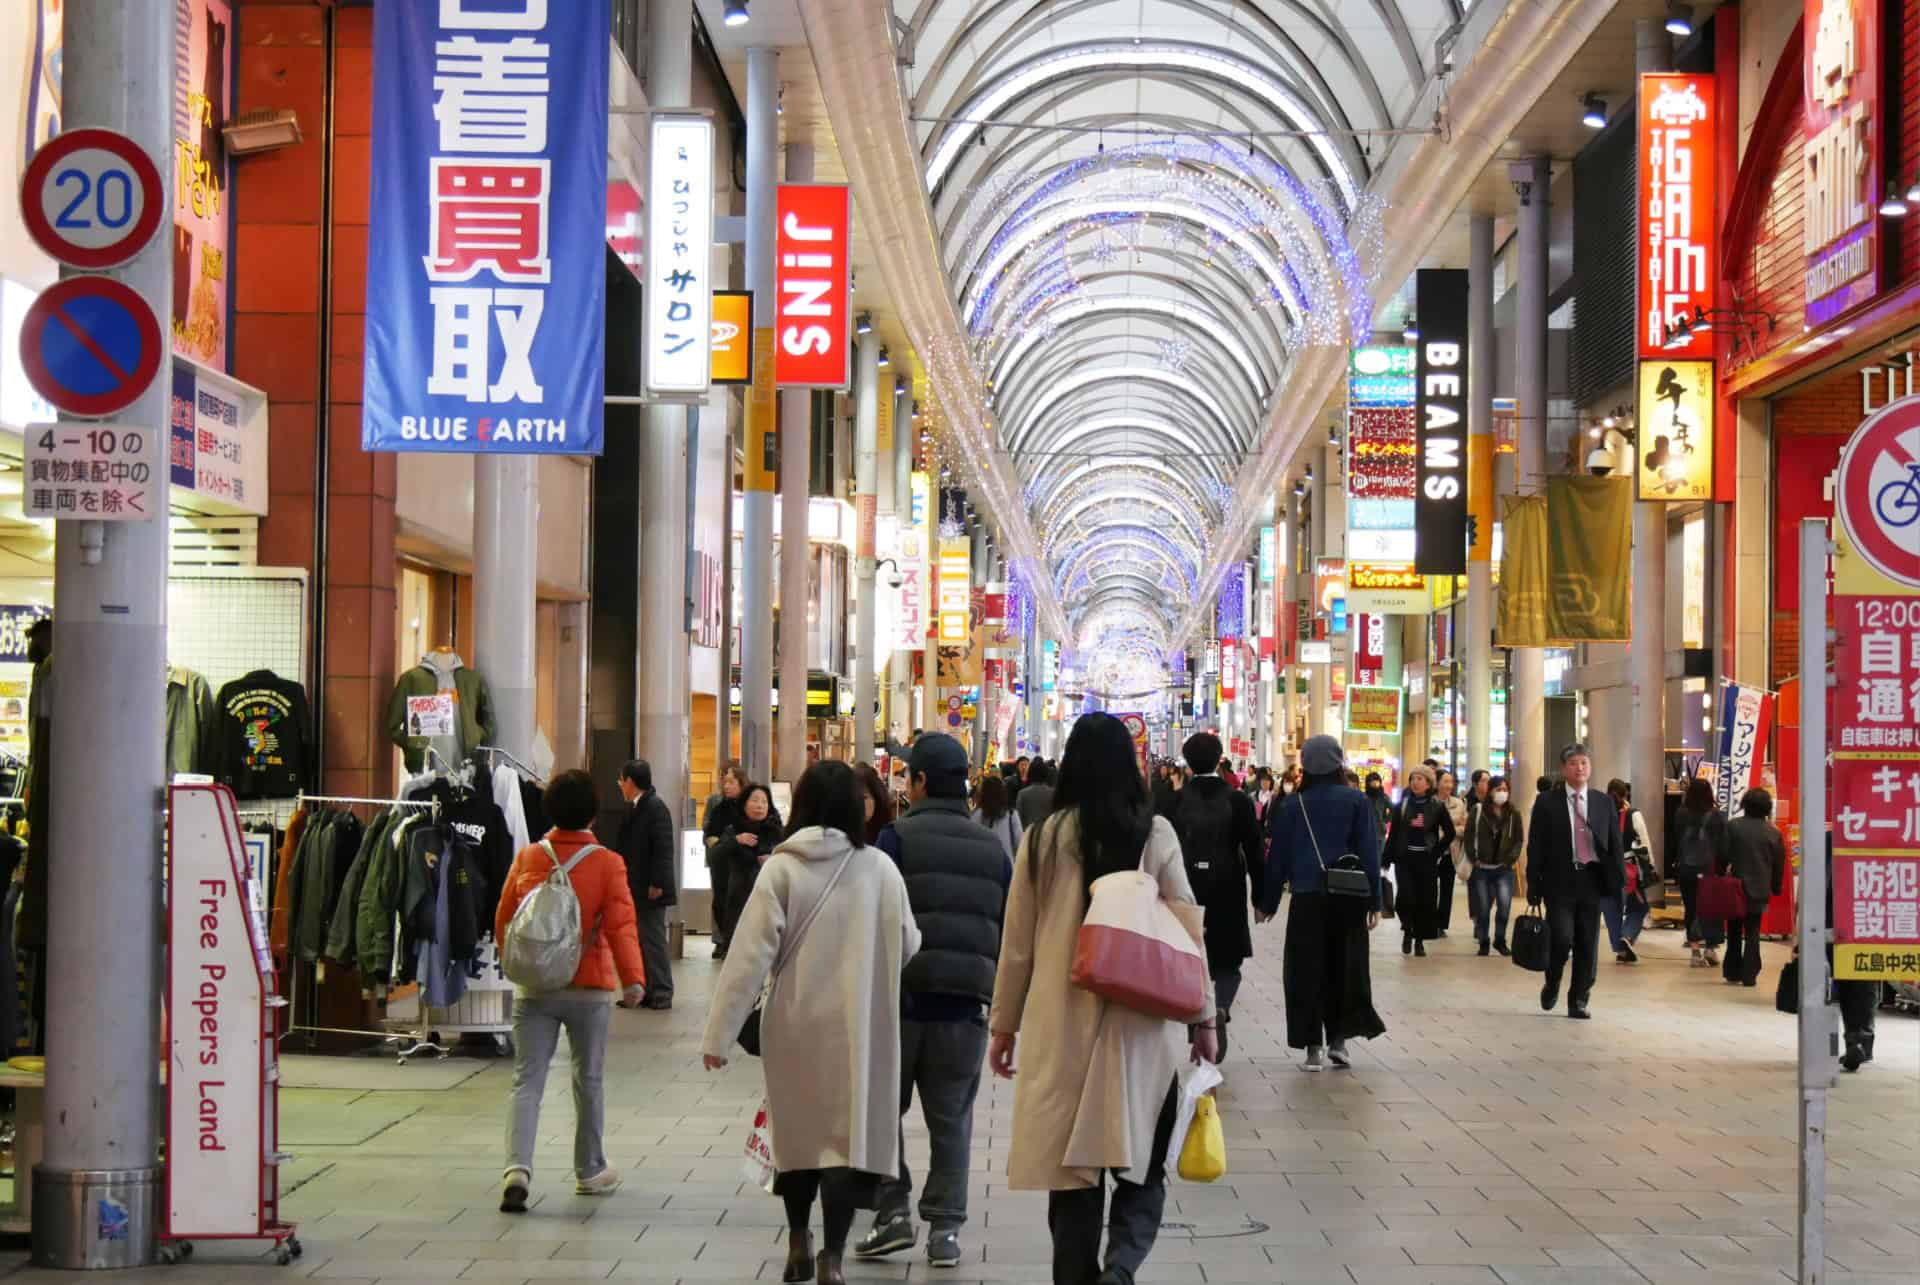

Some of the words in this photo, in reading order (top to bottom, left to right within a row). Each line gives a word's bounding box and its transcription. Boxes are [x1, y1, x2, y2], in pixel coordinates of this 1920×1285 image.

[55, 168, 133, 229] 20
[664, 268, 697, 356] サロン
[401, 415, 468, 441] BLUE
[477, 417, 566, 443] EARTH
[1425, 342, 1460, 501] BEAMS
[31, 459, 150, 484] 貨物集配中の
[32, 489, 145, 513] 車両を除く
[1856, 600, 1920, 628] 12:00
[1860, 630, 1920, 674] 自
[1856, 678, 1920, 723] 通
[1719, 755, 1731, 812] MARION
[1853, 861, 1918, 899] 防犯
[199, 879, 226, 949] Free
[1853, 900, 1919, 938] 設置
[1854, 952, 1920, 973] 広島中央
[192, 965, 226, 1065] Papers
[199, 1081, 226, 1152] Land
